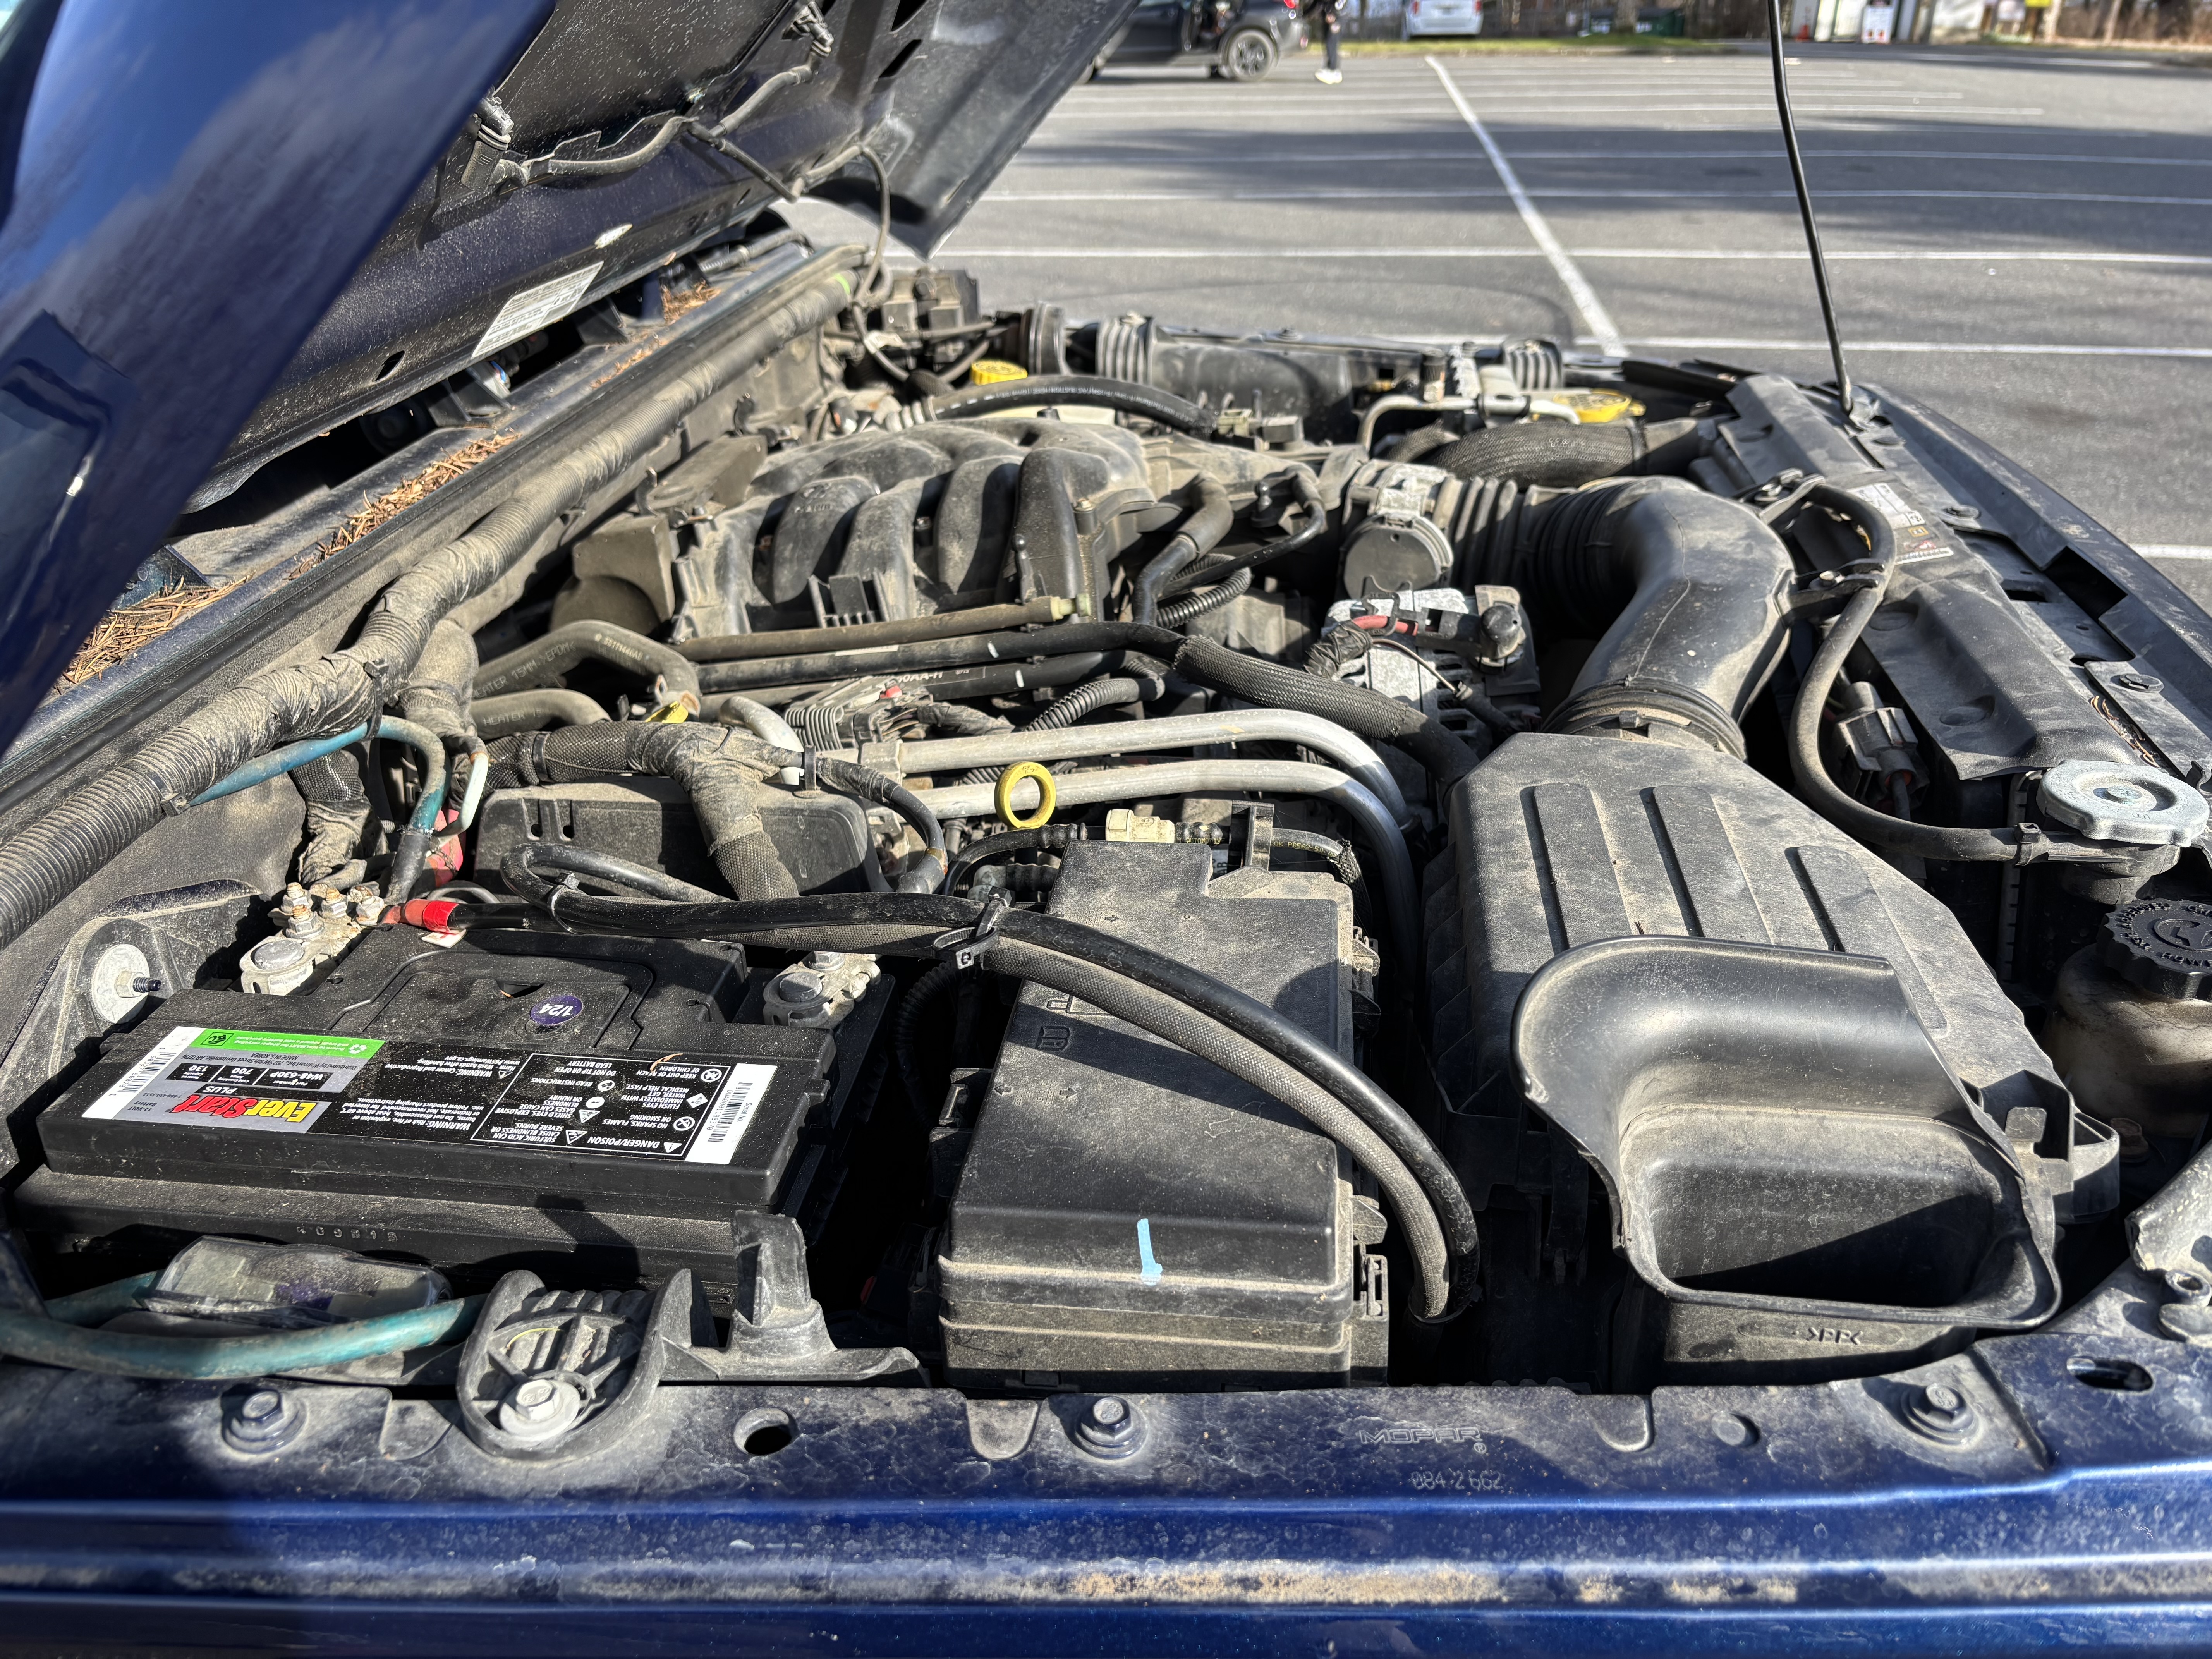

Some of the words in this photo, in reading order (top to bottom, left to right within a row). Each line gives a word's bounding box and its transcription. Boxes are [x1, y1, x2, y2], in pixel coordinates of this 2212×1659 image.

[539, 1003, 574, 1017] 1/24
[417, 1058, 445, 1066] handling.
[444, 1055, 520, 1065] www.P65Warnings.ca.gov
[385, 1063, 424, 1072] Reproductive
[455, 1069, 493, 1077] WARNING:
[530, 1077, 576, 1085] INSTRUCTIONS
[203, 1086, 237, 1094] PLUS
[395, 1099, 423, 1108] charging
[639, 1096, 684, 1104] IMMEDIATELY
[168, 1094, 316, 1123] EverStart
[495, 1107, 530, 1115] EXPLOSIVE
[740, 1103, 752, 1117] Serial
[393, 1111, 433, 1119] disassemble,
[425, 1120, 471, 1130] WARNING:
[501, 1127, 539, 1135] BLINDNESS
[522, 1135, 557, 1143] SULFURIC
[587, 1137, 660, 1148] DANGER/POISON
[1358, 1427, 1483, 1444] MOPAR
